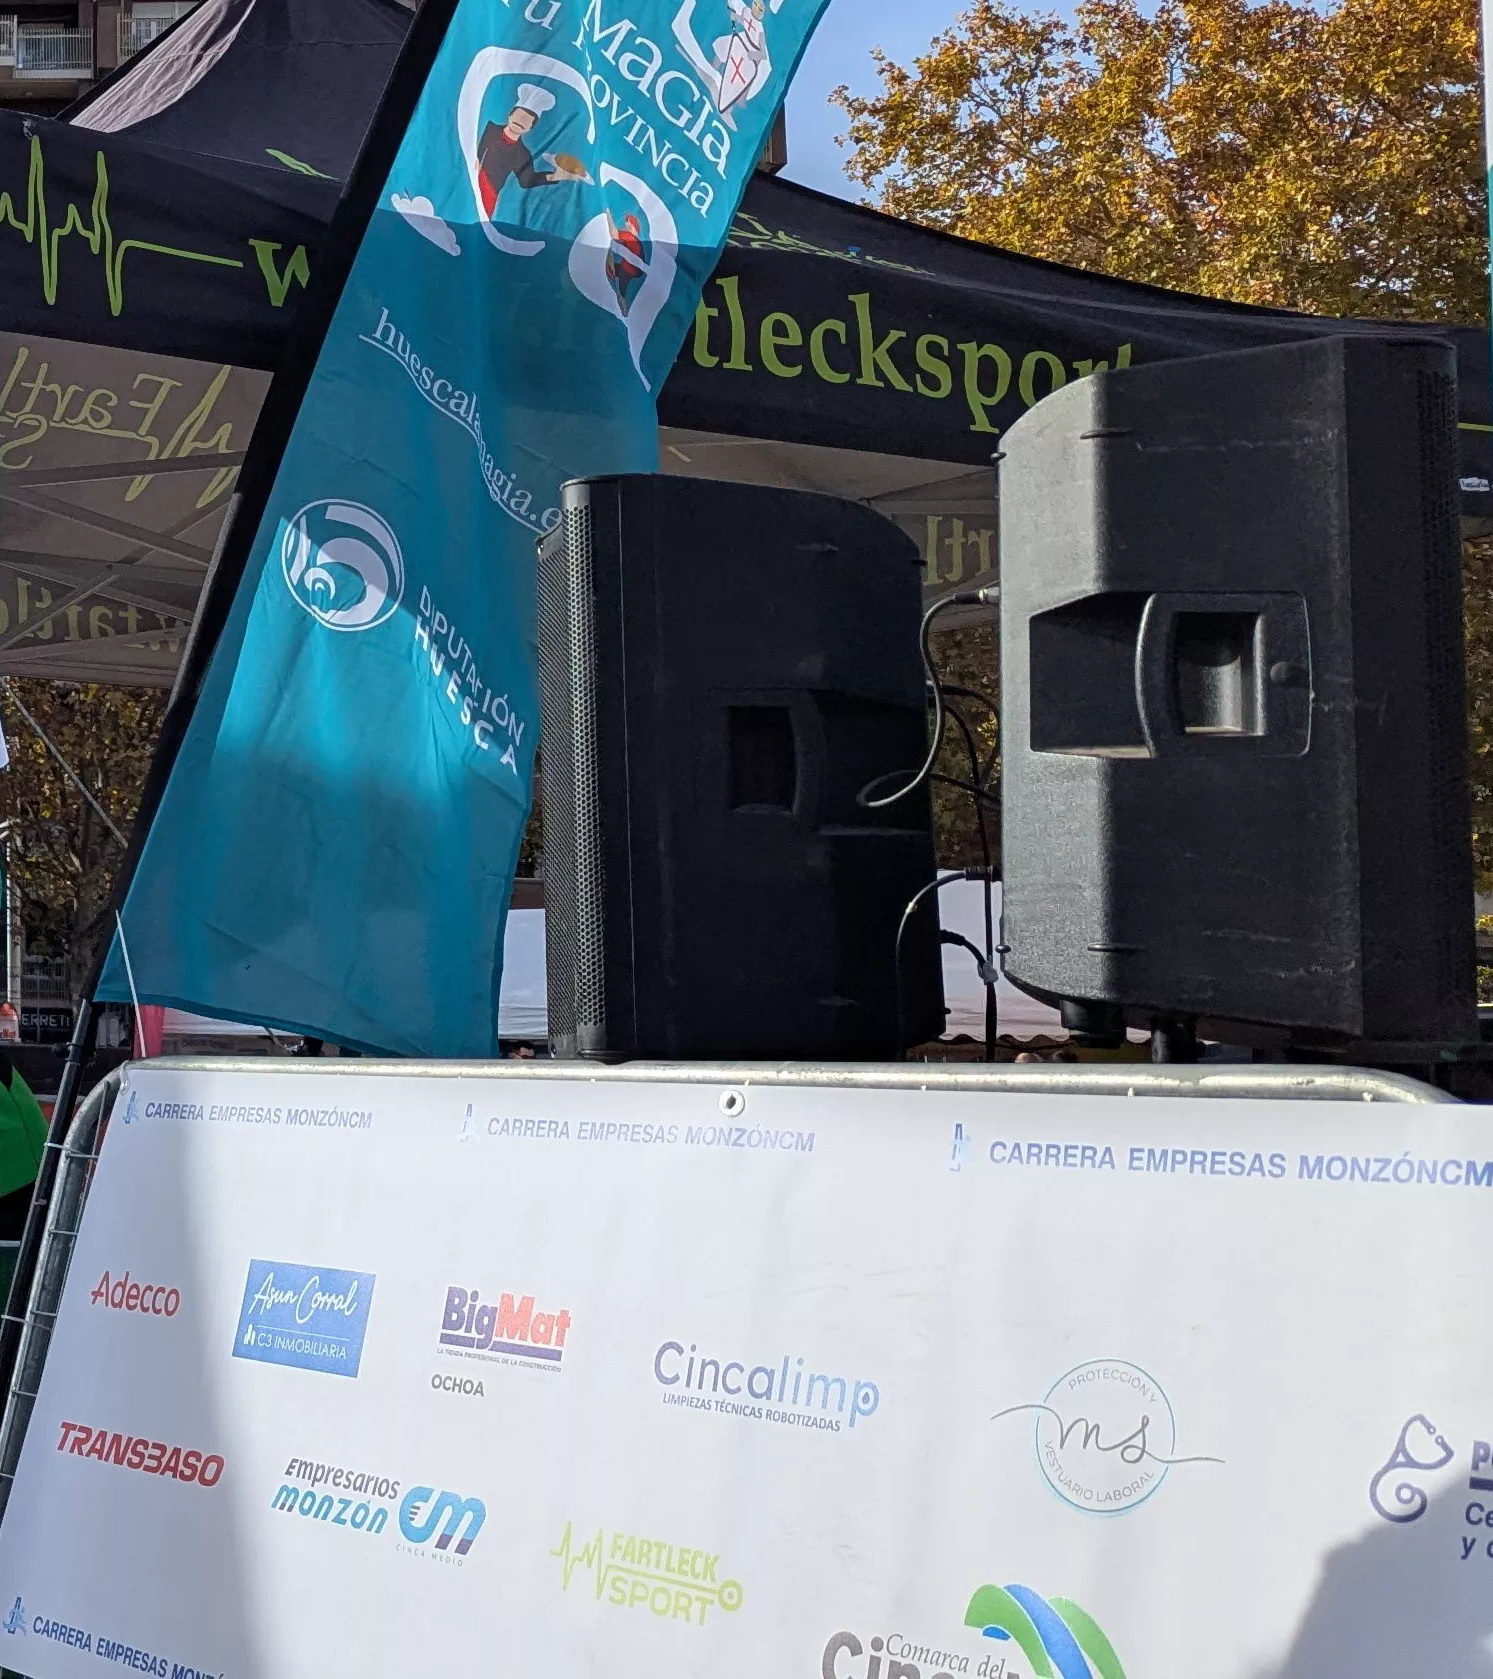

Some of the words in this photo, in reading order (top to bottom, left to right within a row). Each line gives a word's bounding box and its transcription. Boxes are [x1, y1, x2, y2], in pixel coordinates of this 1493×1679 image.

[145, 1102, 204, 1121] CARRERA
[208, 1105, 282, 1124] EMPRESAS
[285, 1106, 373, 1129] MONZÓNCM
[487, 1117, 571, 1141] CARRERA
[577, 1121, 679, 1146] EMPRESAS
[685, 1122, 815, 1153] MONZÓNCM
[989, 1140, 1117, 1171] CARRERA
[1128, 1147, 1287, 1179] EMPRESAS
[1297, 1151, 1493, 1188] MONZÓNCM
[91, 1271, 181, 1316] Adecco
[296, 1276, 358, 1323] Corral
[441, 1286, 571, 1350] BigMat
[257, 1332, 272, 1348] C3
[274, 1334, 347, 1360] INMOBILIARIA
[437, 1347, 444, 1355] LA
[445, 1348, 463, 1358] TIENDA
[464, 1352, 501, 1364] PROFESIONAL
[501, 1357, 509, 1365] DE
[431, 1374, 484, 1397] OCHOA
[654, 1341, 880, 1428] Cincalimp
[1068, 1368, 1150, 1397] PROTECCIÓN
[1148, 1392, 1158, 1403] Y
[663, 1393, 712, 1411] LIMPIEZAS
[714, 1398, 762, 1419] TÉCNICAS
[765, 1410, 841, 1432] ROBOTIZADAS
[57, 1421, 225, 1487] TRANSBASO
[1044, 1440, 1094, 1500] VESTUARIO
[1096, 1470, 1155, 1503] LABORAL
[285, 1458, 401, 1500] Empresarios
[271, 1484, 389, 1534] monzón
[396, 1543, 425, 1558] CINCA
[432, 1552, 463, 1567] MEDIO
[610, 1532, 720, 1582] FARTLECK
[1460, 1536, 1477, 1560] y
[609, 1575, 715, 1626] SPORT
[33, 1616, 91, 1653] CARRERA
[96, 1637, 168, 1678] EMPRESAS
[887, 1633, 969, 1673] Comarca
[977, 1655, 1006, 1679] del
